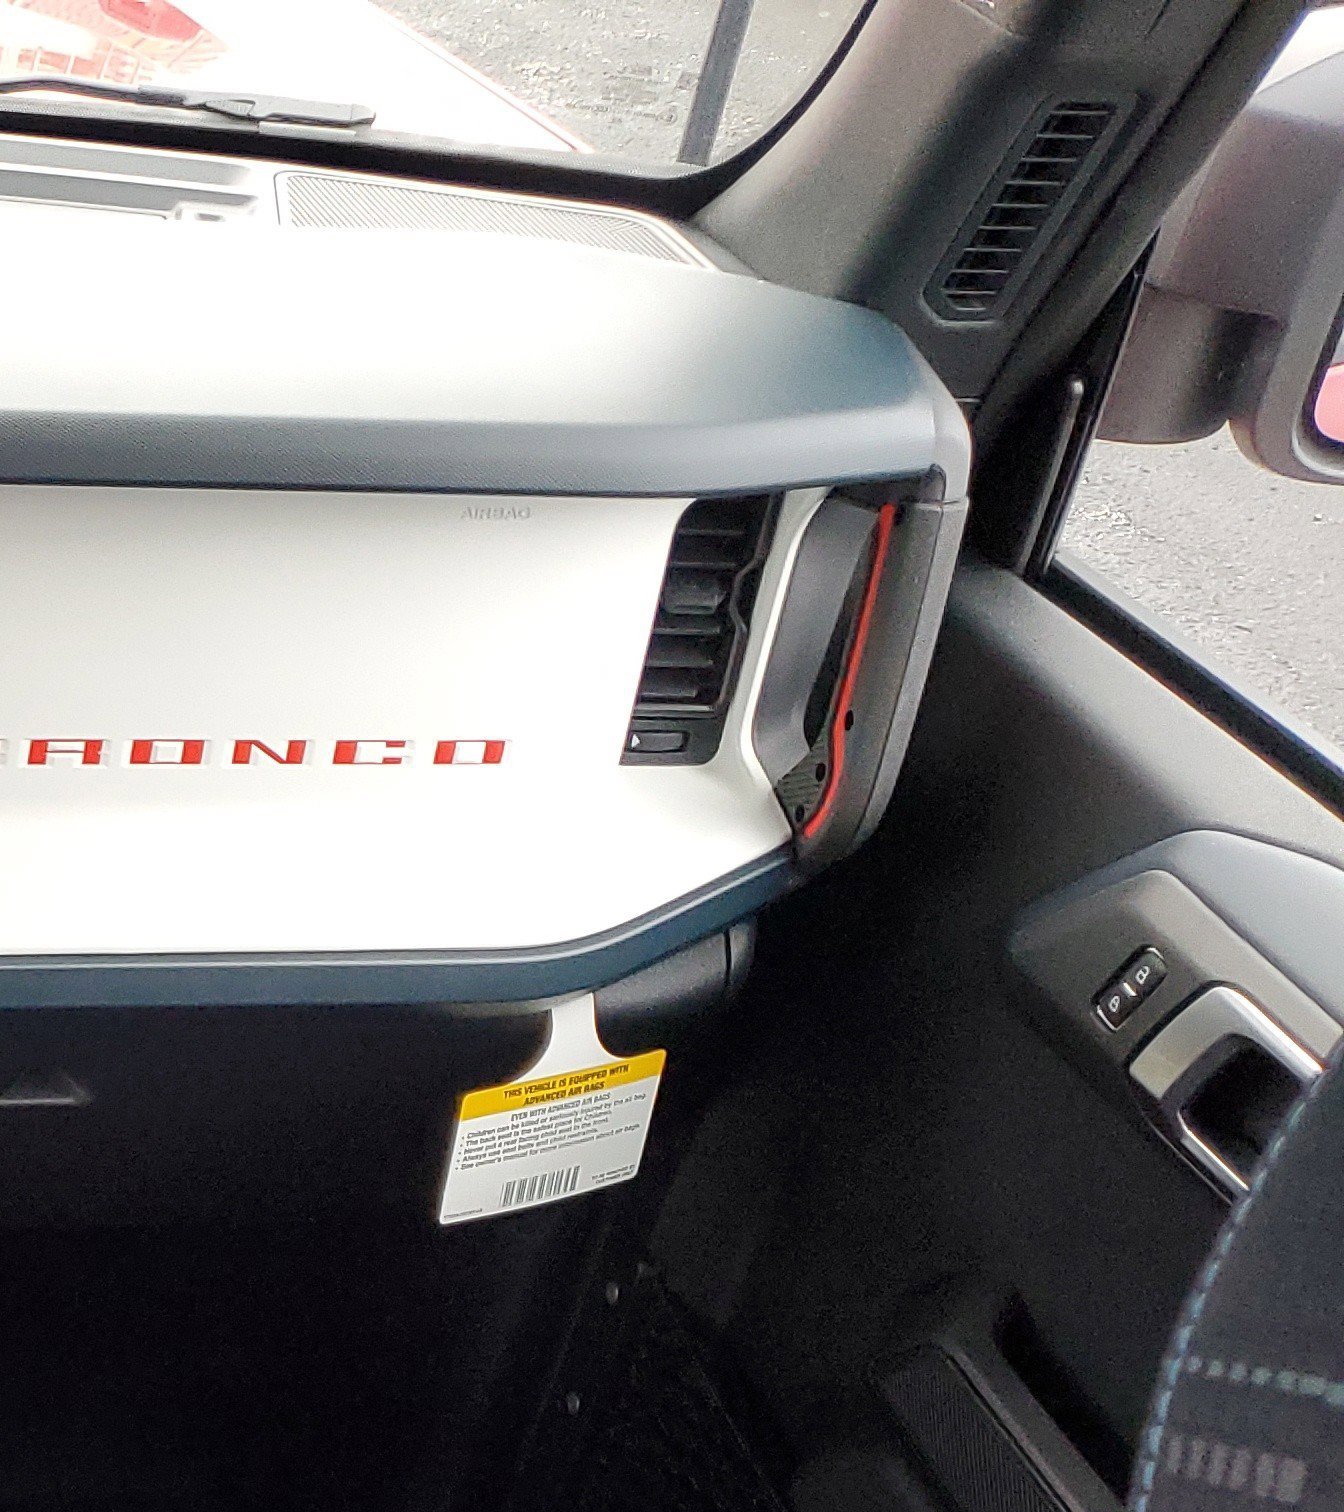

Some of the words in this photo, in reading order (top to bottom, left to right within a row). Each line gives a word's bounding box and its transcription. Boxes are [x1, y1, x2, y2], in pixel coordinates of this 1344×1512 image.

[503, 1087, 521, 1099] THIS
[608, 1063, 629, 1076] WITH
[567, 1085, 582, 1096] AIR
